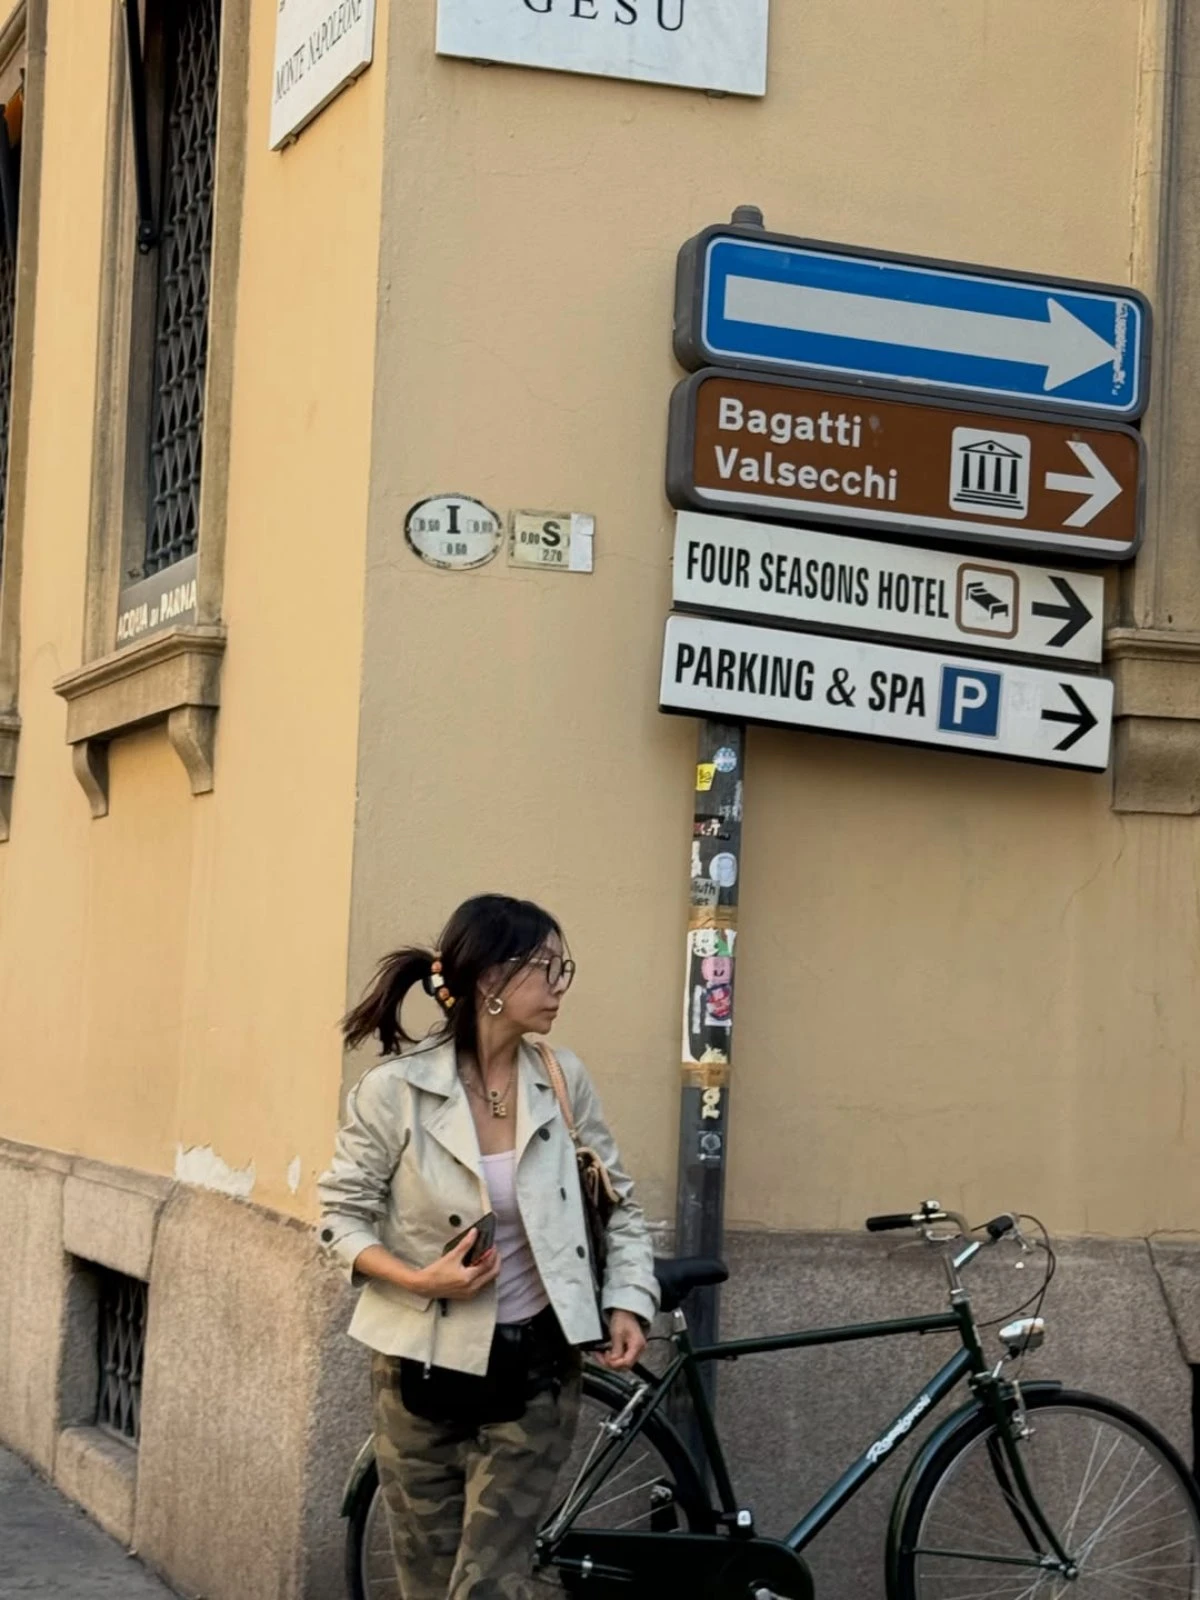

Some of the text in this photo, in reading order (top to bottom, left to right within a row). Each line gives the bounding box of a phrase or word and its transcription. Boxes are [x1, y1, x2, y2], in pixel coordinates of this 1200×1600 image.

[718, 396, 862, 448] Bagatti
[714, 445, 898, 501] Valsecchi
[446, 505, 461, 534] I
[541, 521, 561, 547] S
[687, 540, 950, 619] FOUR SEASONS HOTEL
[675, 642, 815, 701] PARKING
[825, 667, 857, 708] &
[868, 670, 926, 717] SPA
